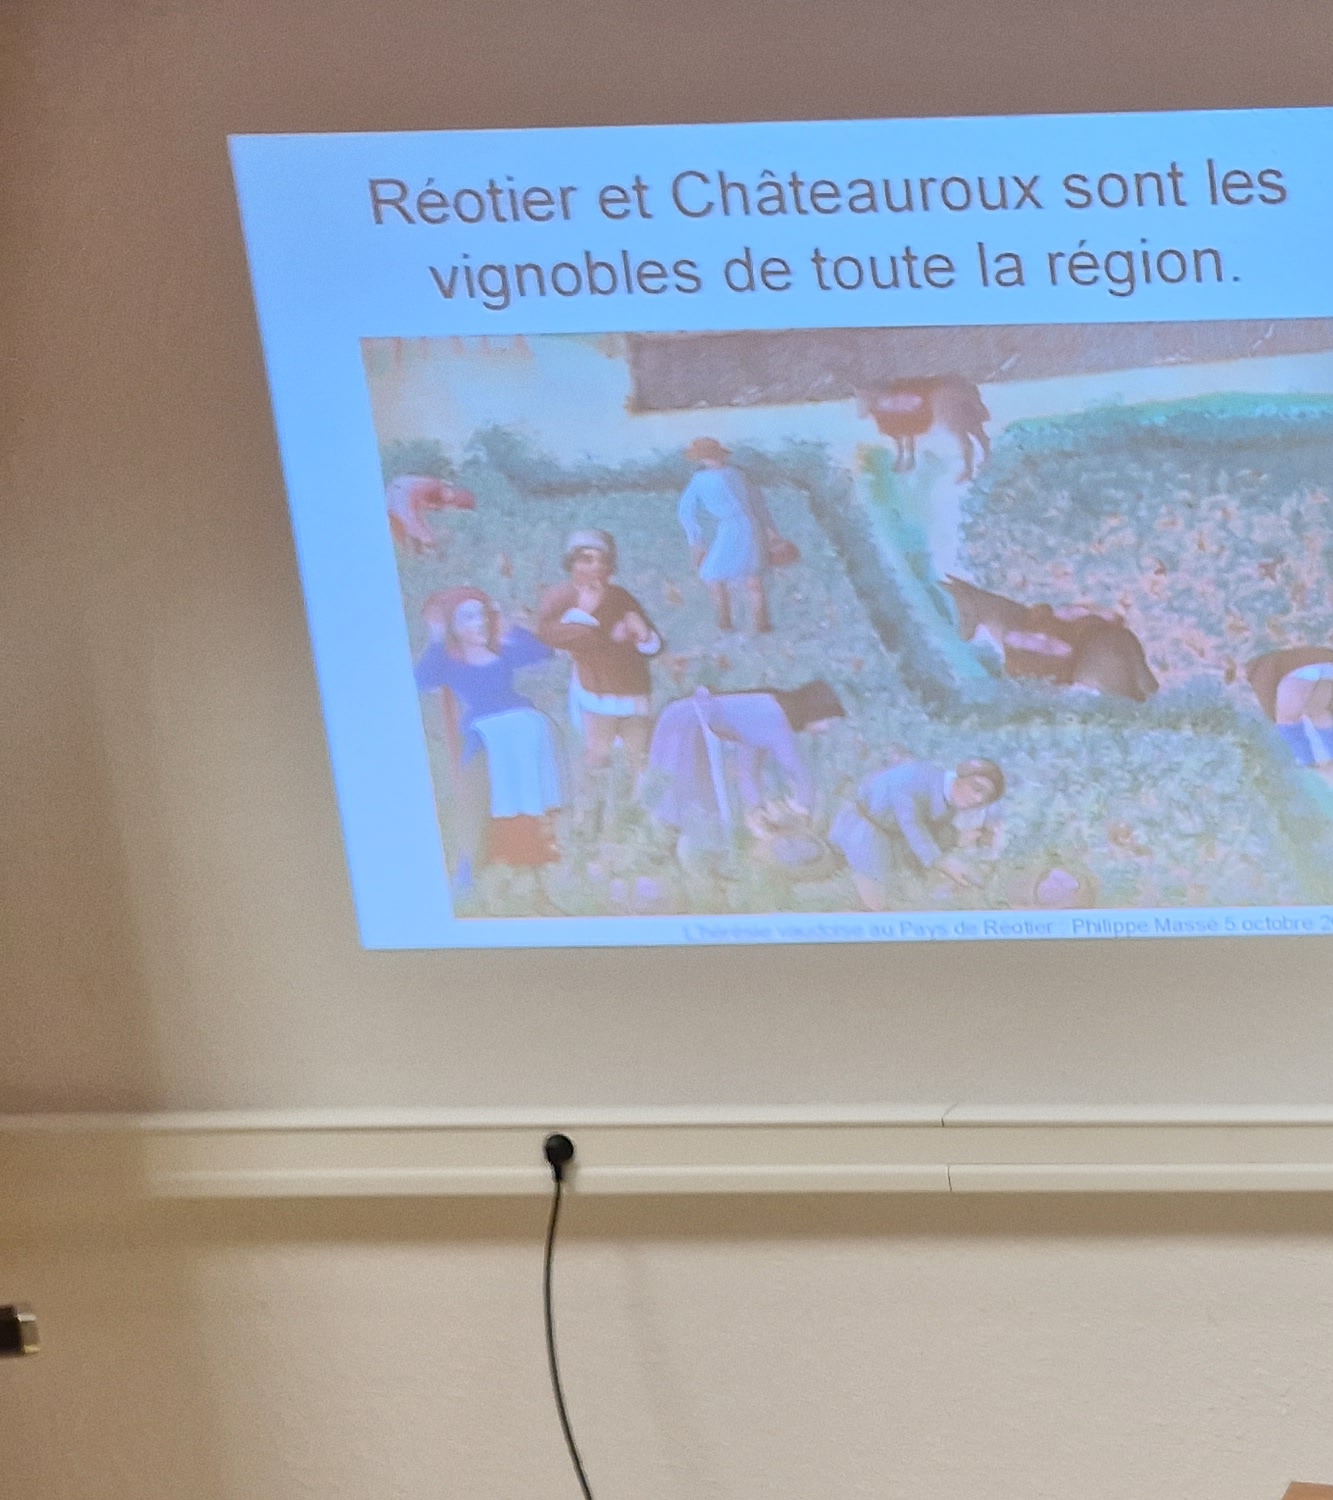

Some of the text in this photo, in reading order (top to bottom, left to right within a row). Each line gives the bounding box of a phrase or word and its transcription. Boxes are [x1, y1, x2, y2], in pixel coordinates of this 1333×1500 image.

[367, 156, 1289, 226] Réotier et Châteauroux sont les
[427, 237, 1244, 312] vignobles de toute la région.
[872, 924, 894, 938] au
[899, 920, 948, 940] Pays
[954, 921, 978, 936] de
[1071, 917, 1149, 939] Philippe
[1223, 915, 1236, 932] 5
[1242, 915, 1313, 932] octobre
